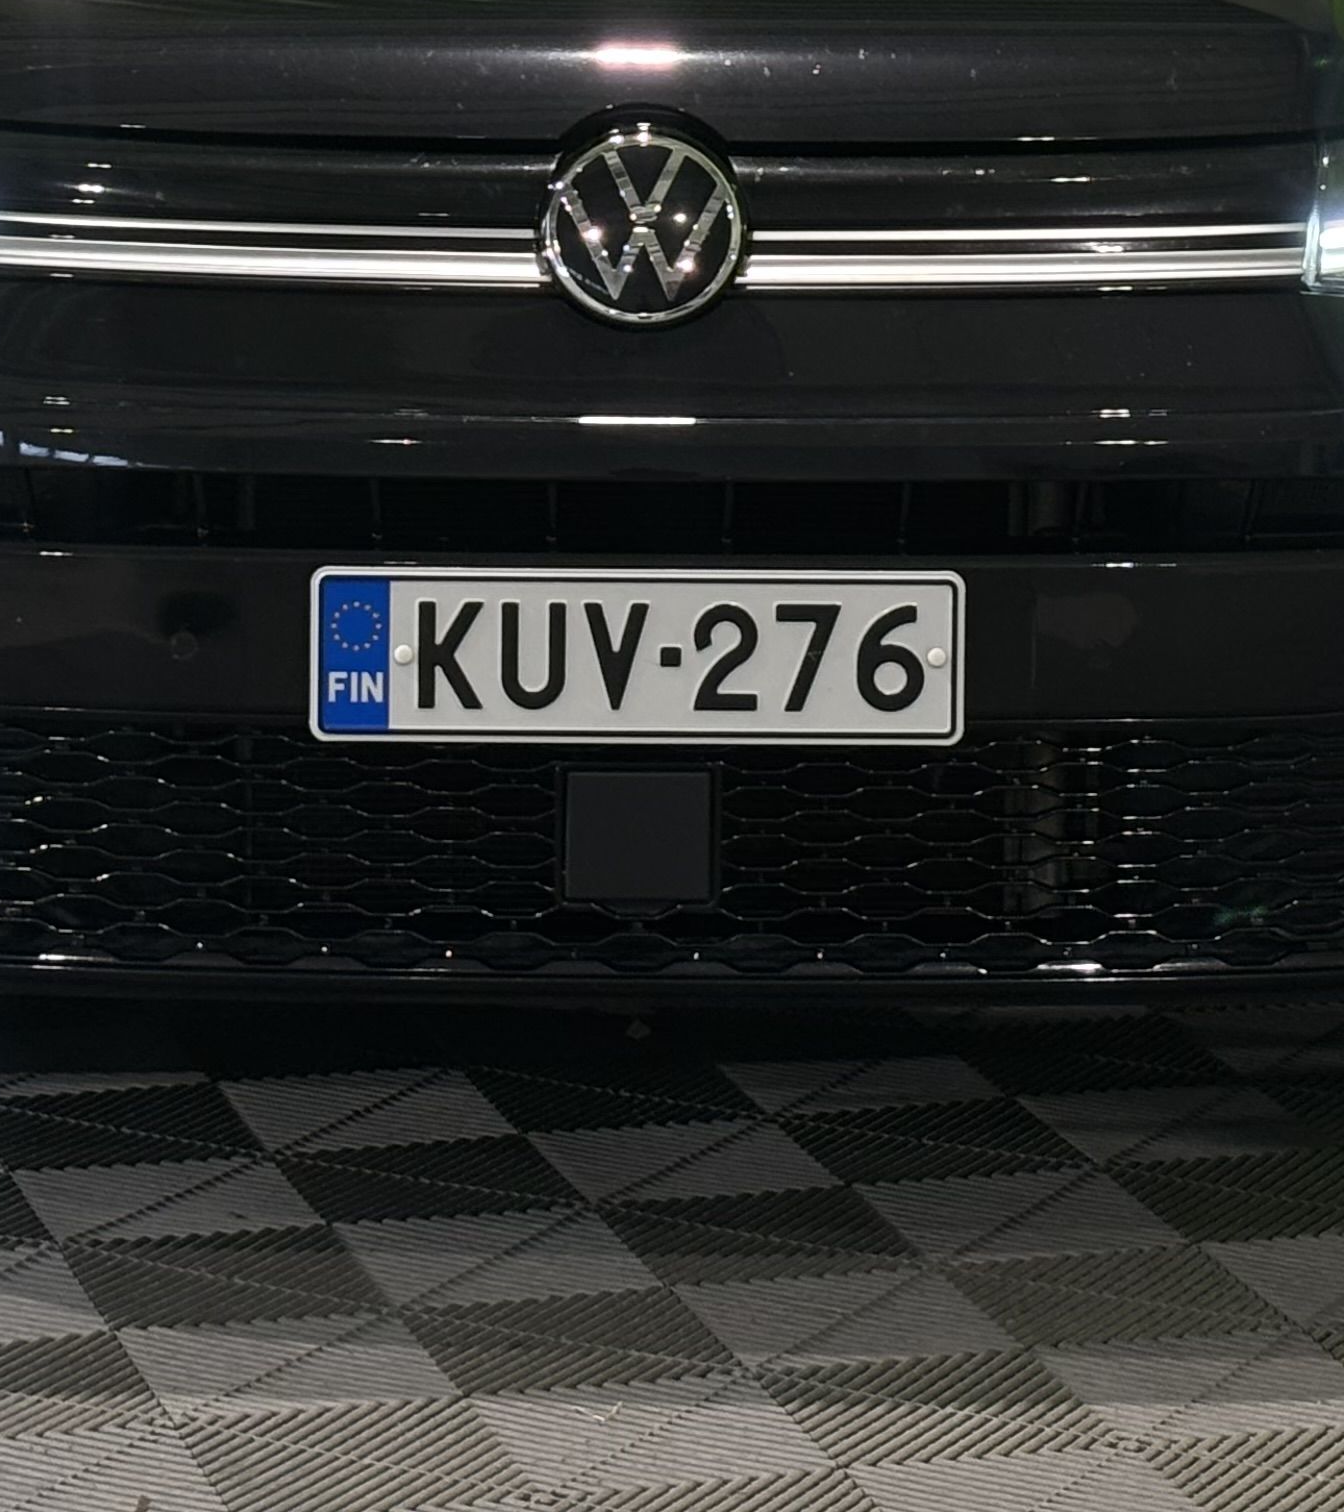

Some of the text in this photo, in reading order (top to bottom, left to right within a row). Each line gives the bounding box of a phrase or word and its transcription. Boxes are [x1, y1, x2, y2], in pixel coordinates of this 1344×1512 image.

[553, 140, 731, 302] VW
[327, 670, 384, 703] FIN
[417, 601, 925, 713] KUV-276
